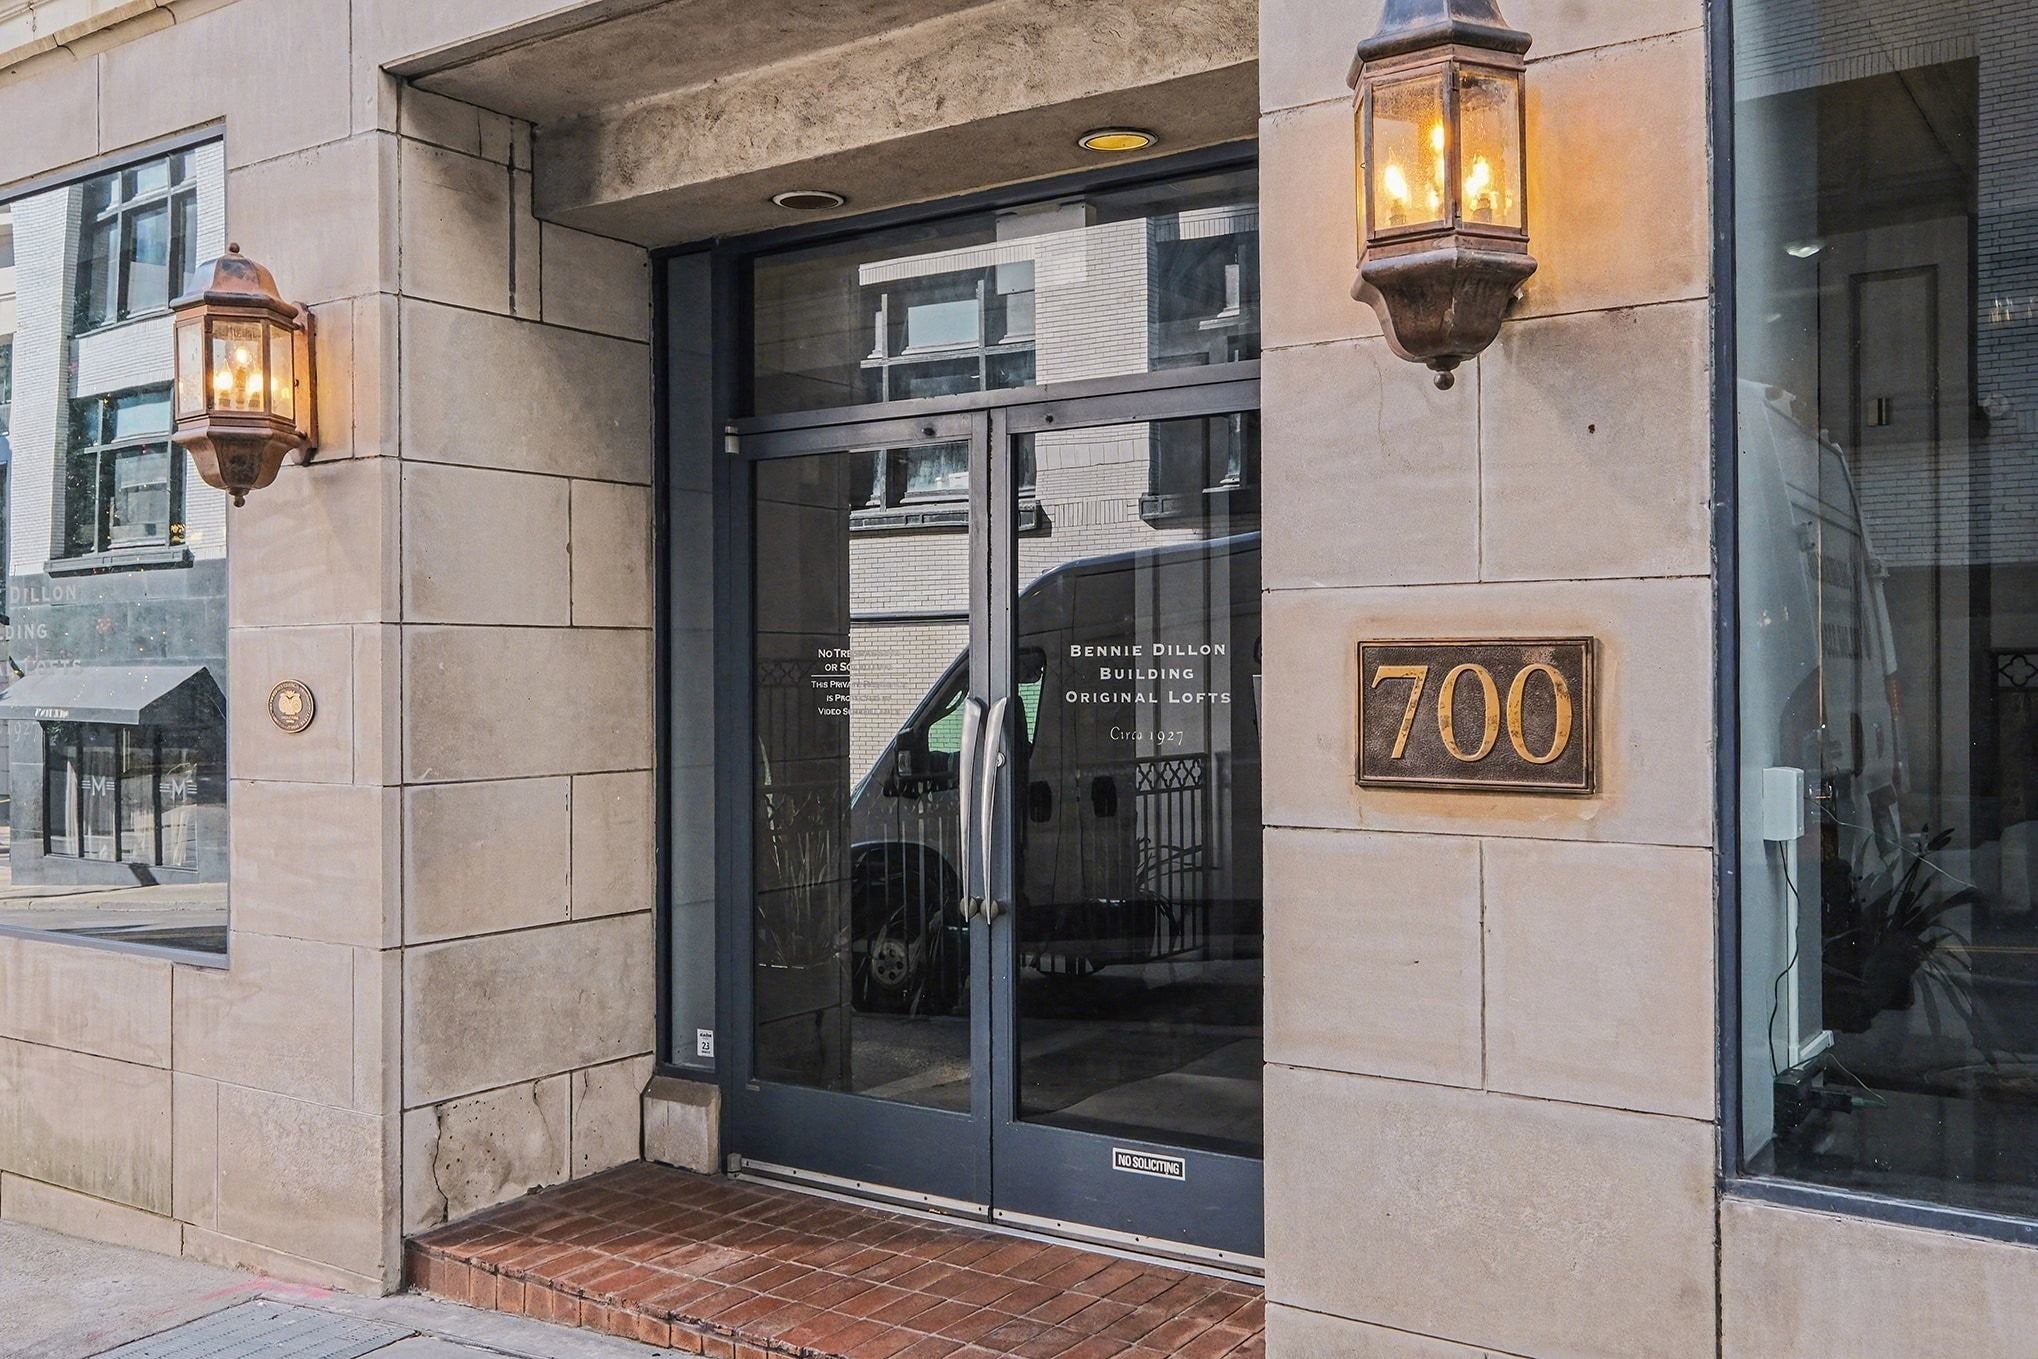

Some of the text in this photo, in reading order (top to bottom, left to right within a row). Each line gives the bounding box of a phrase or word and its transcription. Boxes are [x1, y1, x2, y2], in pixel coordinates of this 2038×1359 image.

[10, 585, 77, 603] DILLON
[818, 649, 833, 658] NO
[1070, 643, 1226, 657] BENNIE DILLON
[824, 663, 838, 672] OR
[1100, 667, 1194, 680] BUILDING
[1065, 691, 1232, 704] ORIGINAL LOFTS
[817, 707, 842, 716] VIDEO
[1371, 663, 1573, 765] 700
[1110, 726, 1184, 745] Circa 1927
[1118, 1153, 1180, 1175] NO SOLICITING
